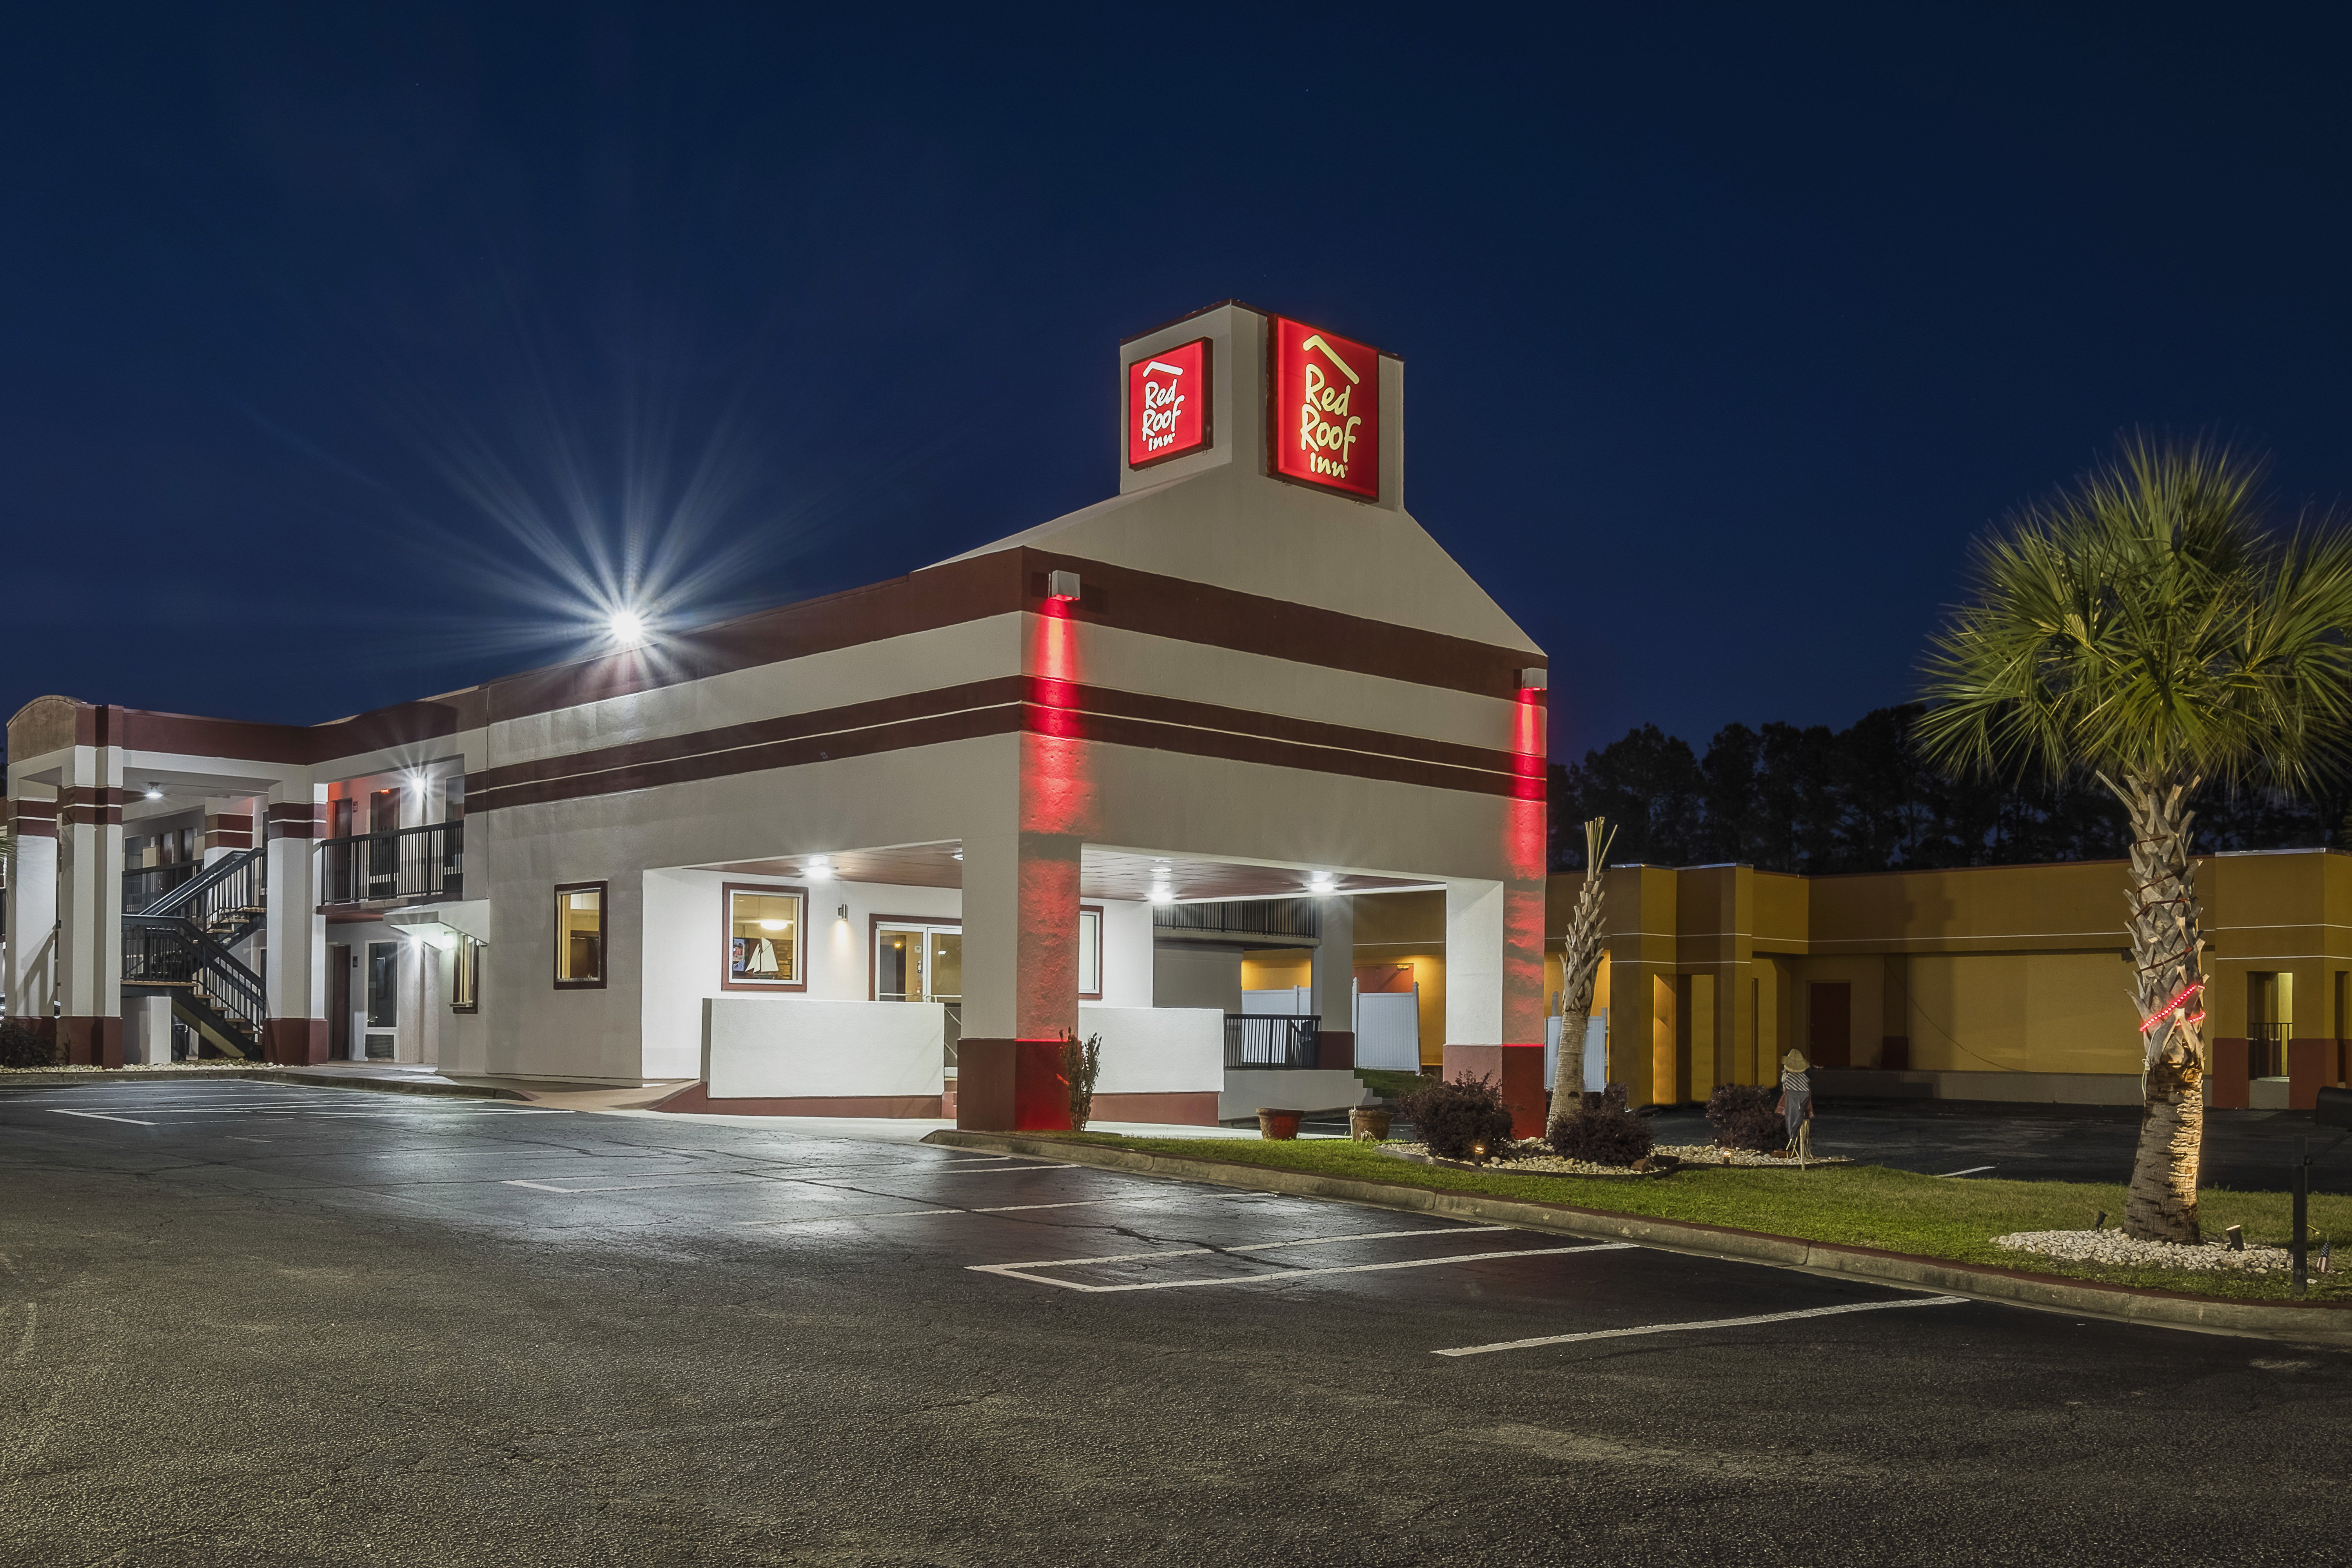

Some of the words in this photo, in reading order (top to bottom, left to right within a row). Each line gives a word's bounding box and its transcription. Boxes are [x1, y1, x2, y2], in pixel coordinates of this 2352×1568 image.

[1145, 378, 1177, 409] Red
[1305, 363, 1351, 417] Red
[1142, 395, 1185, 442] Roof
[1300, 403, 1361, 463] Roof
